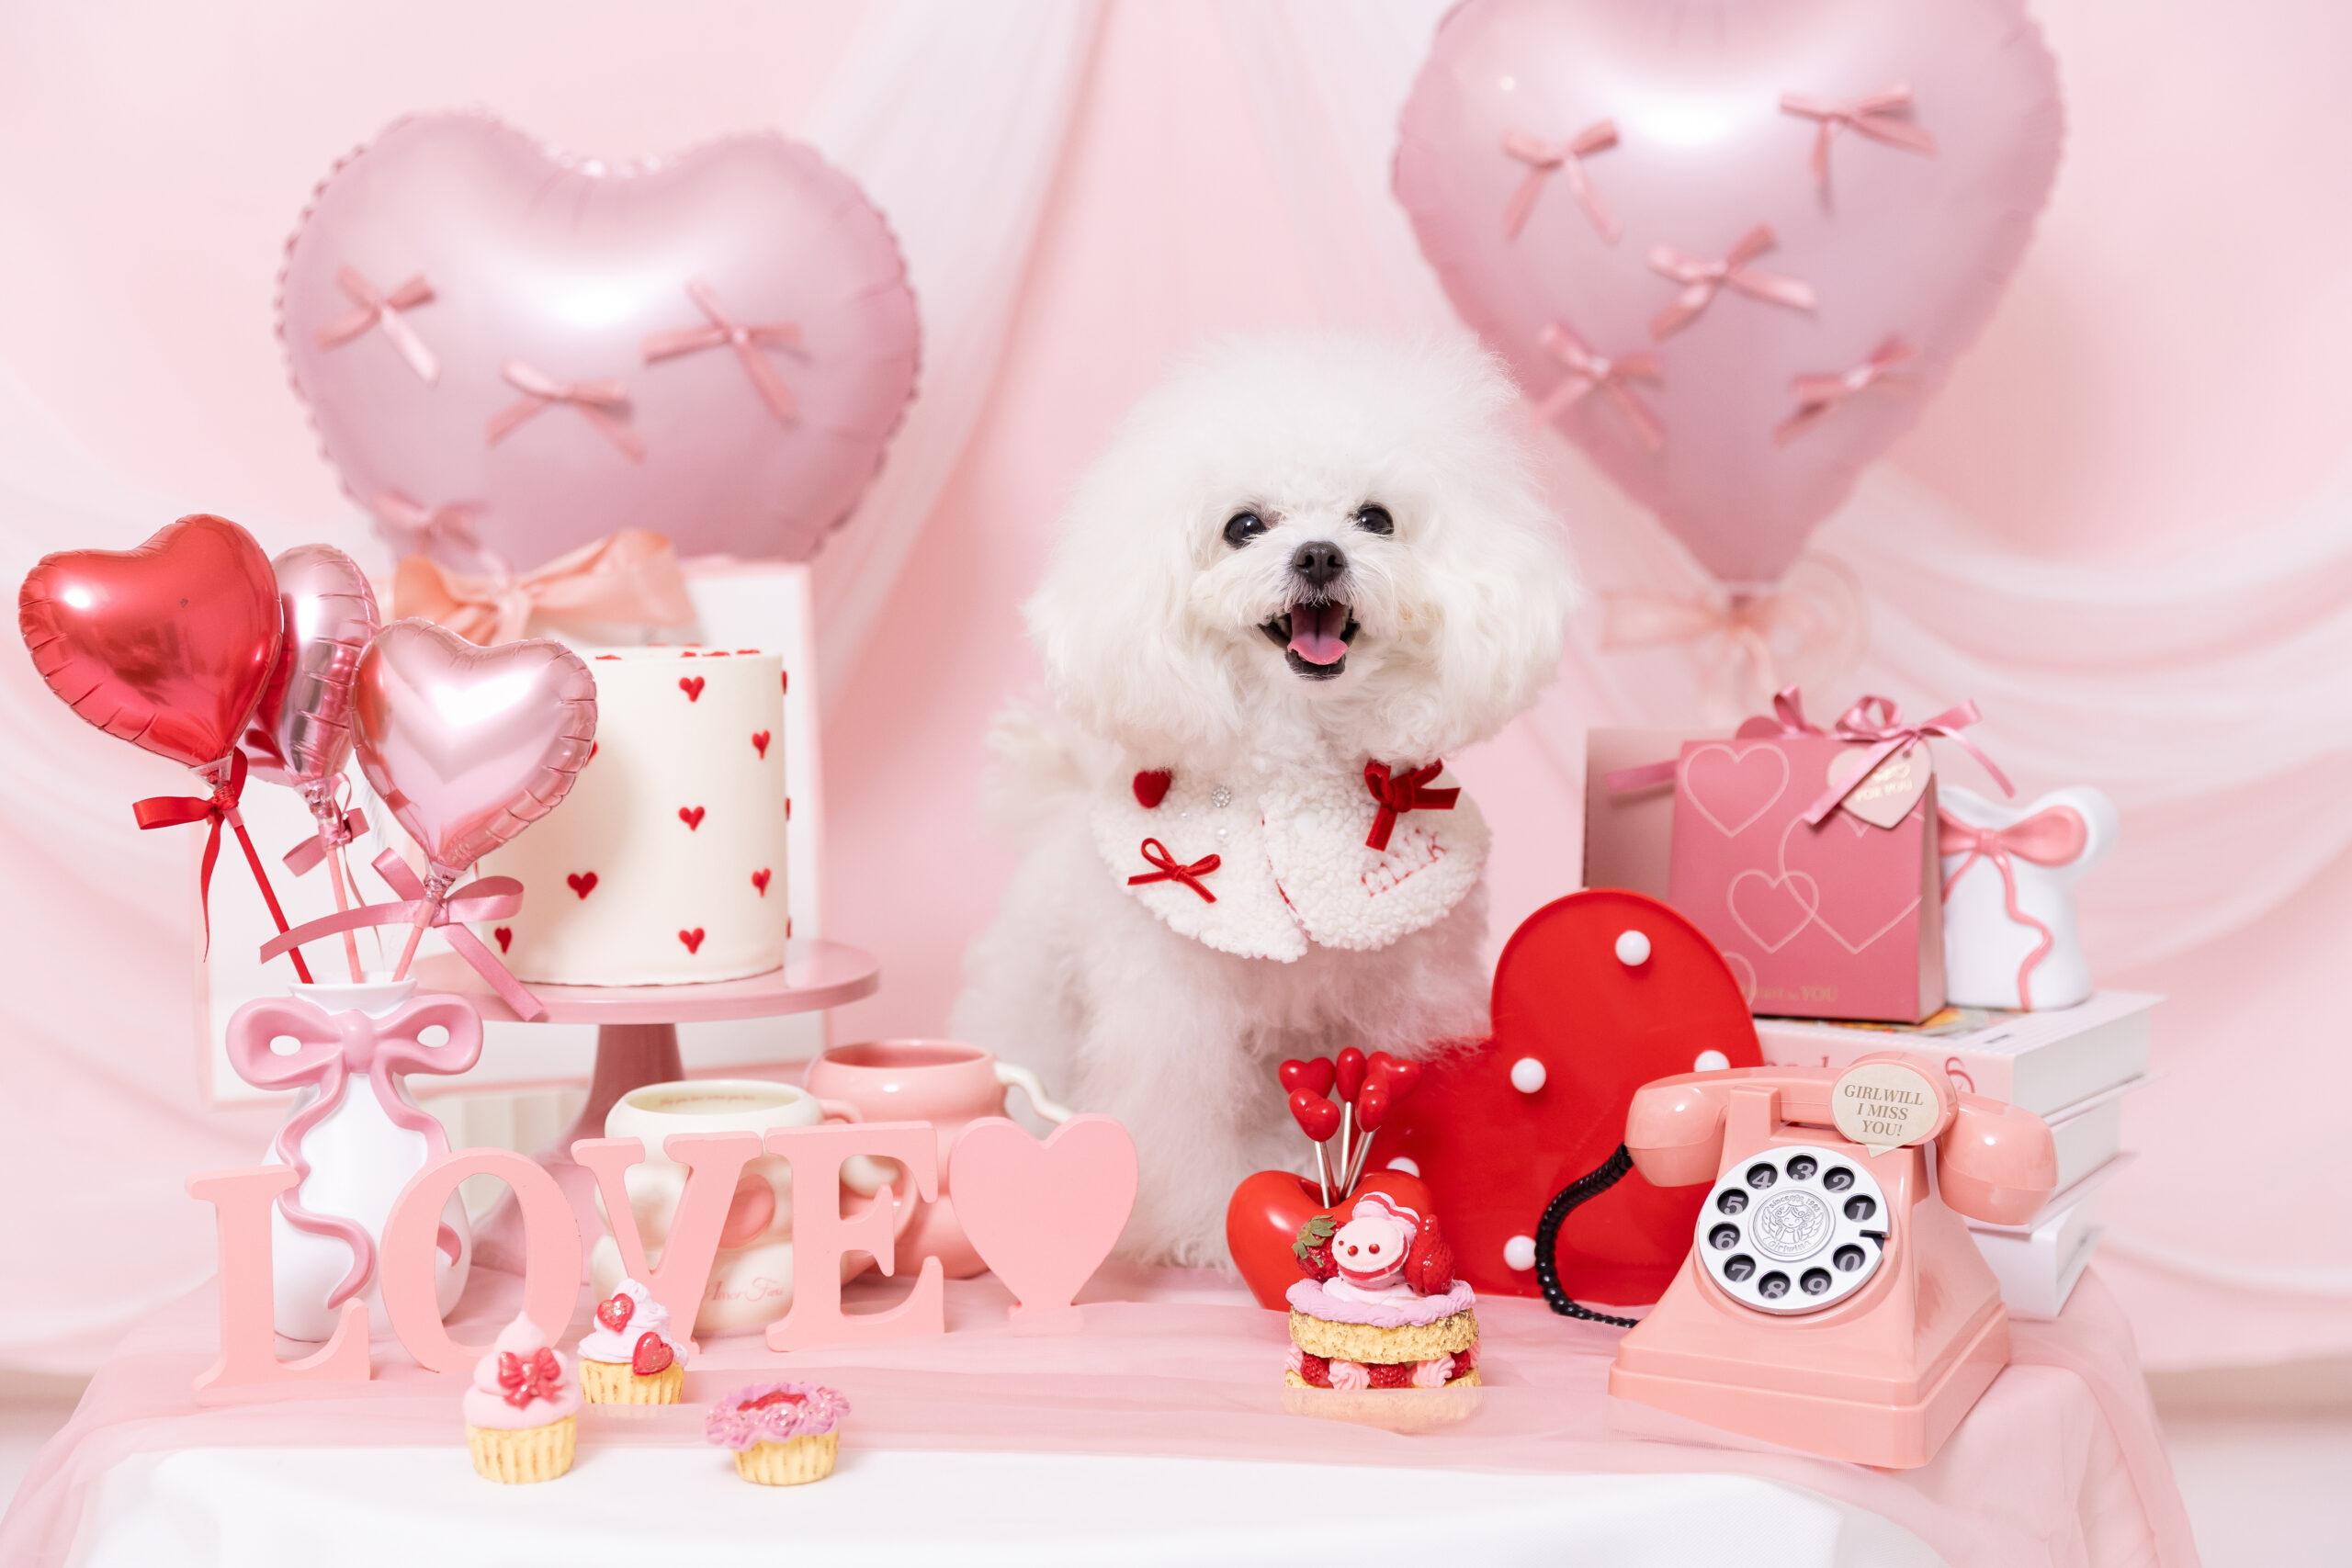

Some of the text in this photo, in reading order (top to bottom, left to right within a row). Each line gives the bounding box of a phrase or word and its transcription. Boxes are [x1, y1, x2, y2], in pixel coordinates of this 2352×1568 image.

[1884, 779, 1913, 795] YOU
[1857, 1103, 1909, 1120] I MISS
[1862, 1120, 1903, 1136] YOU!
[1752, 1170, 1771, 1190] 4
[1792, 1163, 1815, 1180] 3
[1828, 1175, 1851, 1192] 2
[1724, 1196, 1744, 1215] 5
[1850, 1202, 1868, 1222] 1
[1714, 1231, 1736, 1250] 6
[185, 1121, 944, 1407] LOVE
[1838, 1253, 1860, 1272] 0
[1731, 1264, 1751, 1282] 7
[1763, 1281, 1786, 1299] 8
[1806, 1278, 1828, 1296] 9
